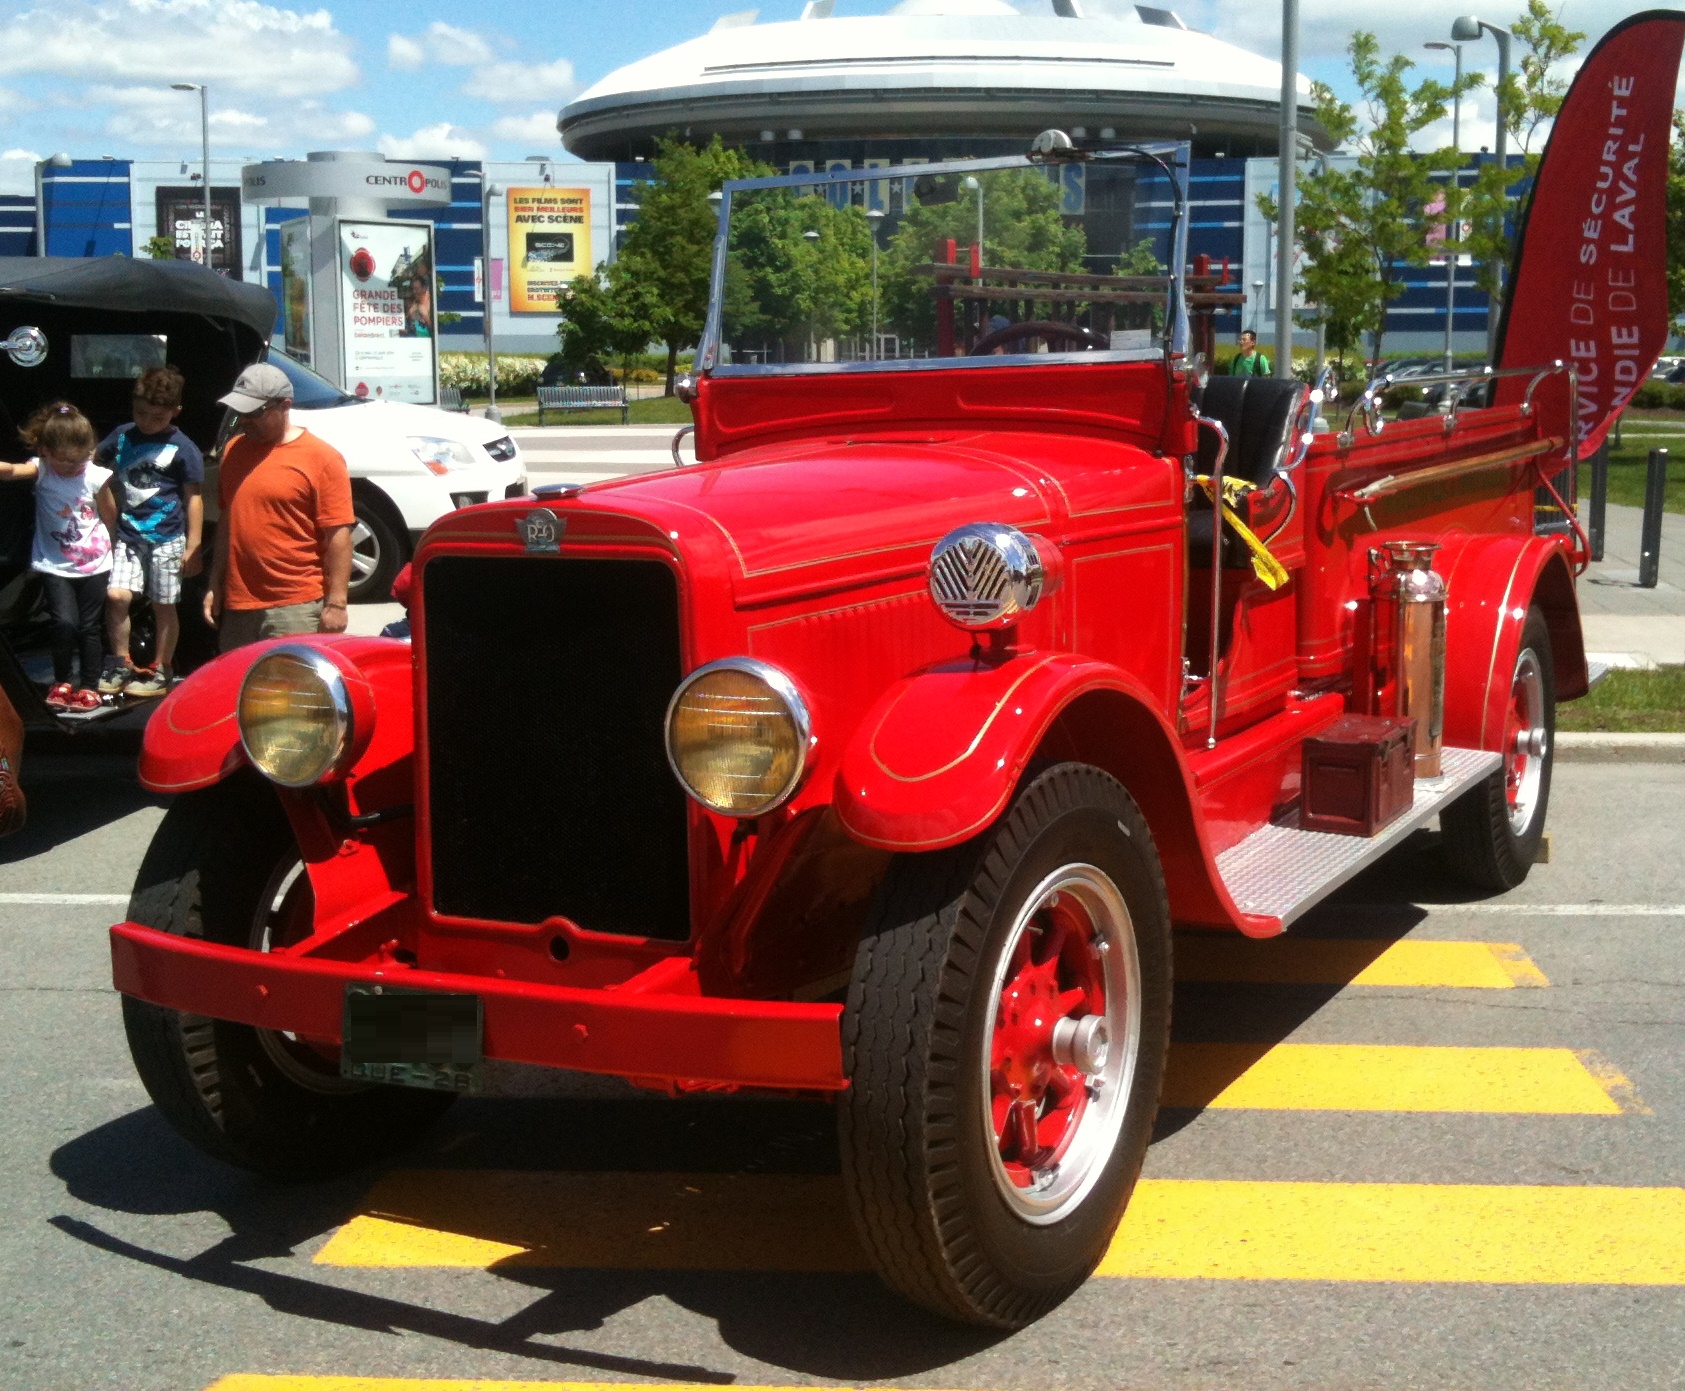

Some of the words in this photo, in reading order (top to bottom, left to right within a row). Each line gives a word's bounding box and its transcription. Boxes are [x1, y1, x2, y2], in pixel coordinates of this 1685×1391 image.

[1579, 75, 1635, 266] SÉCURITÉ
[365, 170, 448, 194] CENTROPOLIS
[513, 197, 530, 205] LES
[1609, 133, 1645, 253] LAVAL
[515, 214, 546, 224] AVEC
[547, 213, 585, 224] SCÈNE
[352, 289, 396, 300] GRANDE
[1608, 268, 1637, 311] DE
[353, 301, 380, 313] FÊTE
[382, 303, 403, 313] DES
[1570, 279, 1594, 325] DE
[353, 315, 404, 326] POMPIERS
